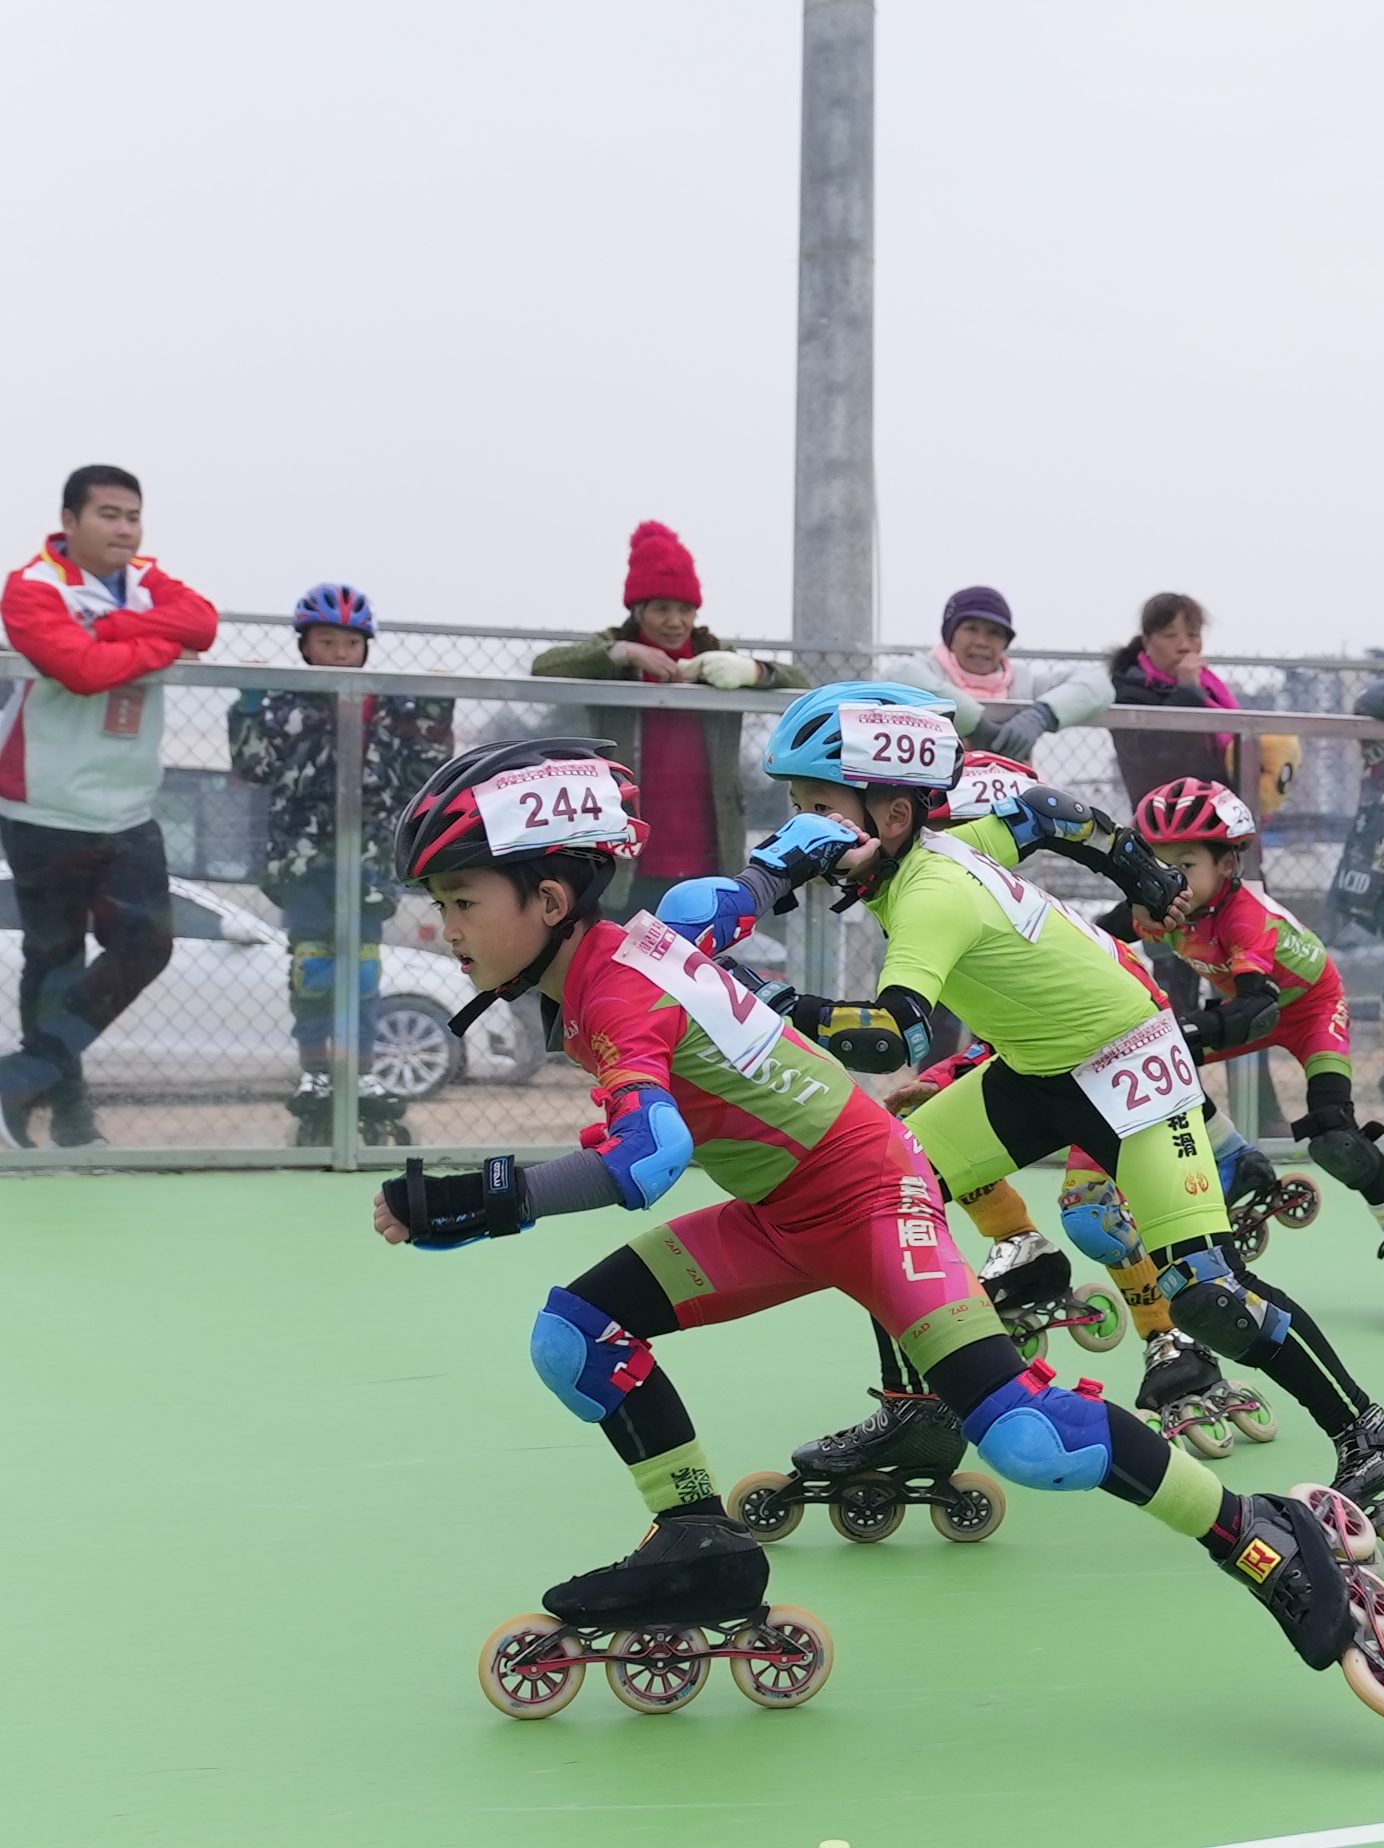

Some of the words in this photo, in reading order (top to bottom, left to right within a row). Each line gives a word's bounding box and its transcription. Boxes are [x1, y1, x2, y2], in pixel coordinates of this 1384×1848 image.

[872, 732, 937, 767] 296
[519, 786, 603, 829] 244
[971, 778, 1020, 803] 281
[1111, 1044, 1193, 1112] 296
